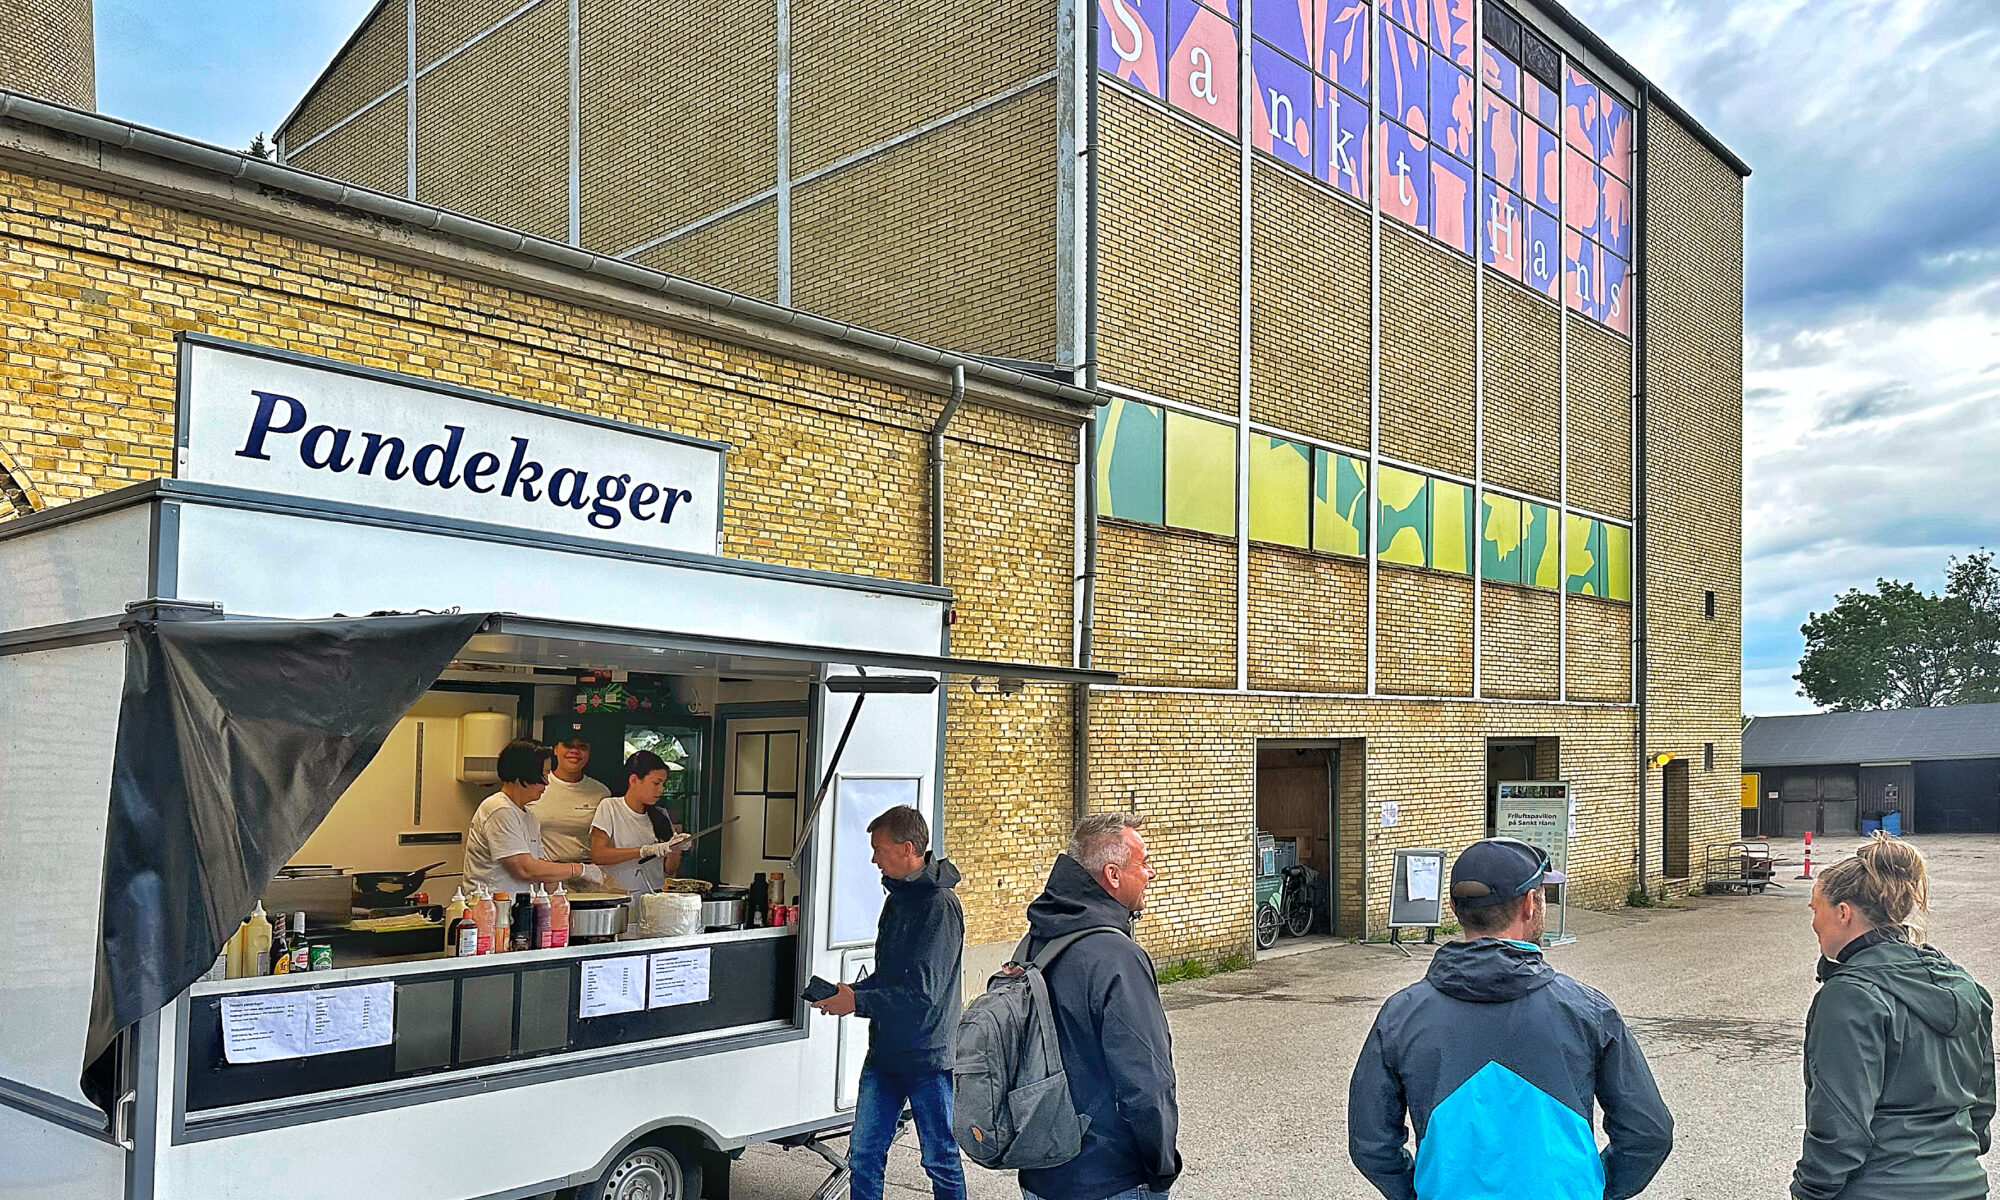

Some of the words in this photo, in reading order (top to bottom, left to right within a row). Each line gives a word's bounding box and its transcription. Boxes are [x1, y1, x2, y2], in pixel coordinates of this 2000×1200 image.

[1111, 0, 1412, 206] Sankt
[1489, 194, 1620, 318] Hans
[235, 390, 691, 530] Pandekager
[1508, 819, 1516, 827] på
